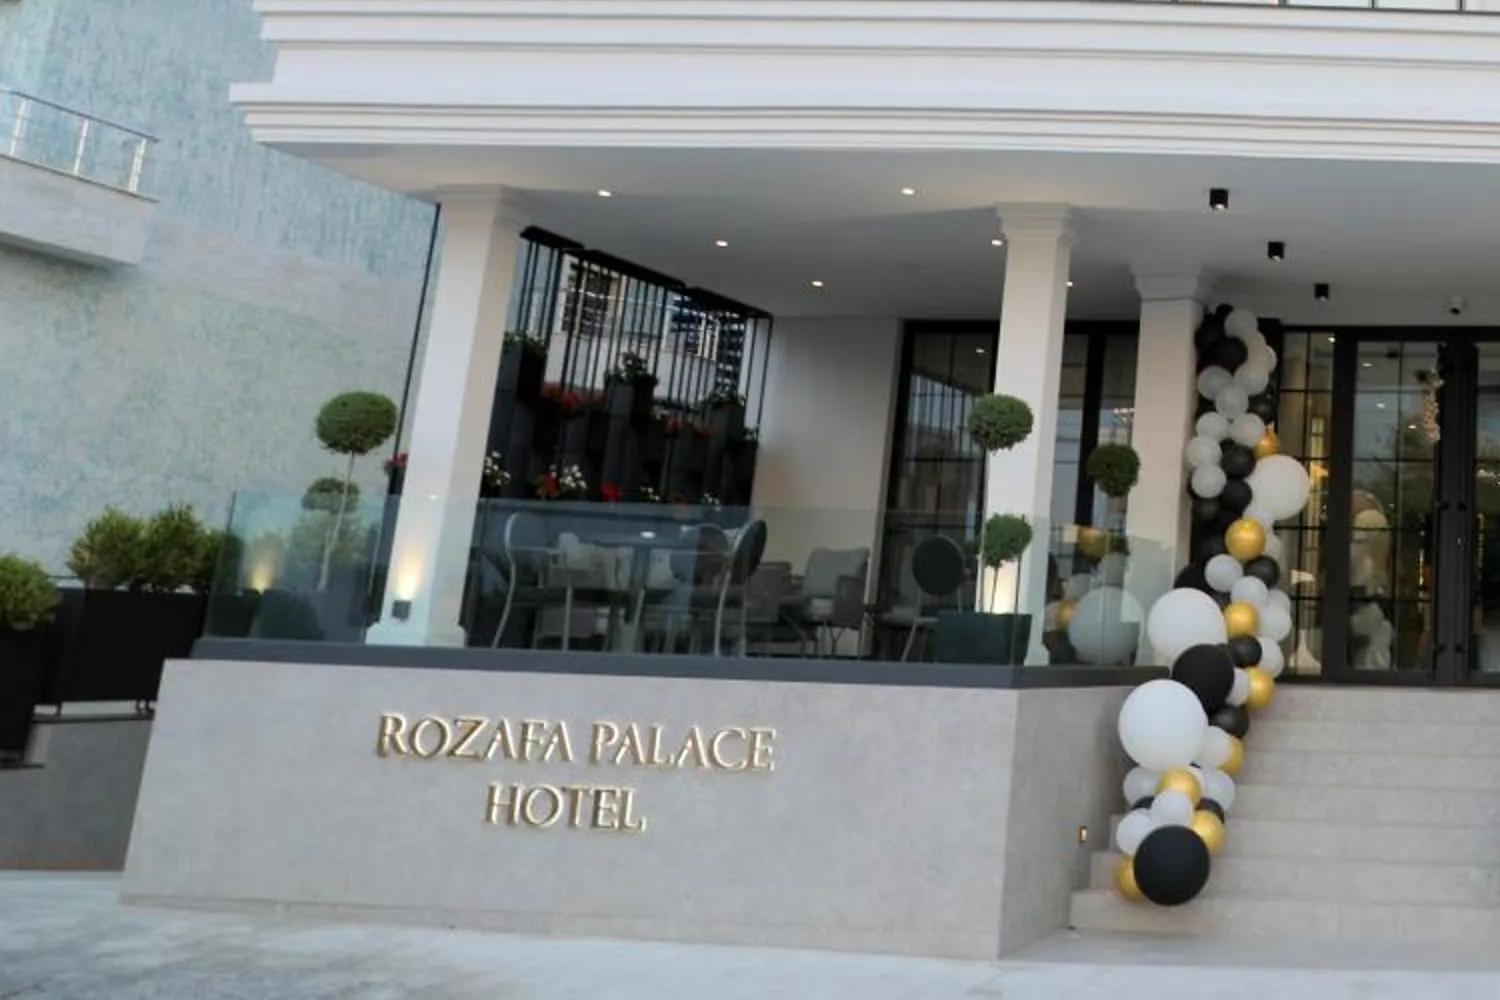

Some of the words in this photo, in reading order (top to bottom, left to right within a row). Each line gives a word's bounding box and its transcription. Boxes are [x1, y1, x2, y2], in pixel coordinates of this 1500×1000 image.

[376, 712, 573, 762] ROZAFA
[588, 720, 777, 772] PALACE
[484, 783, 648, 833] HOTEL
